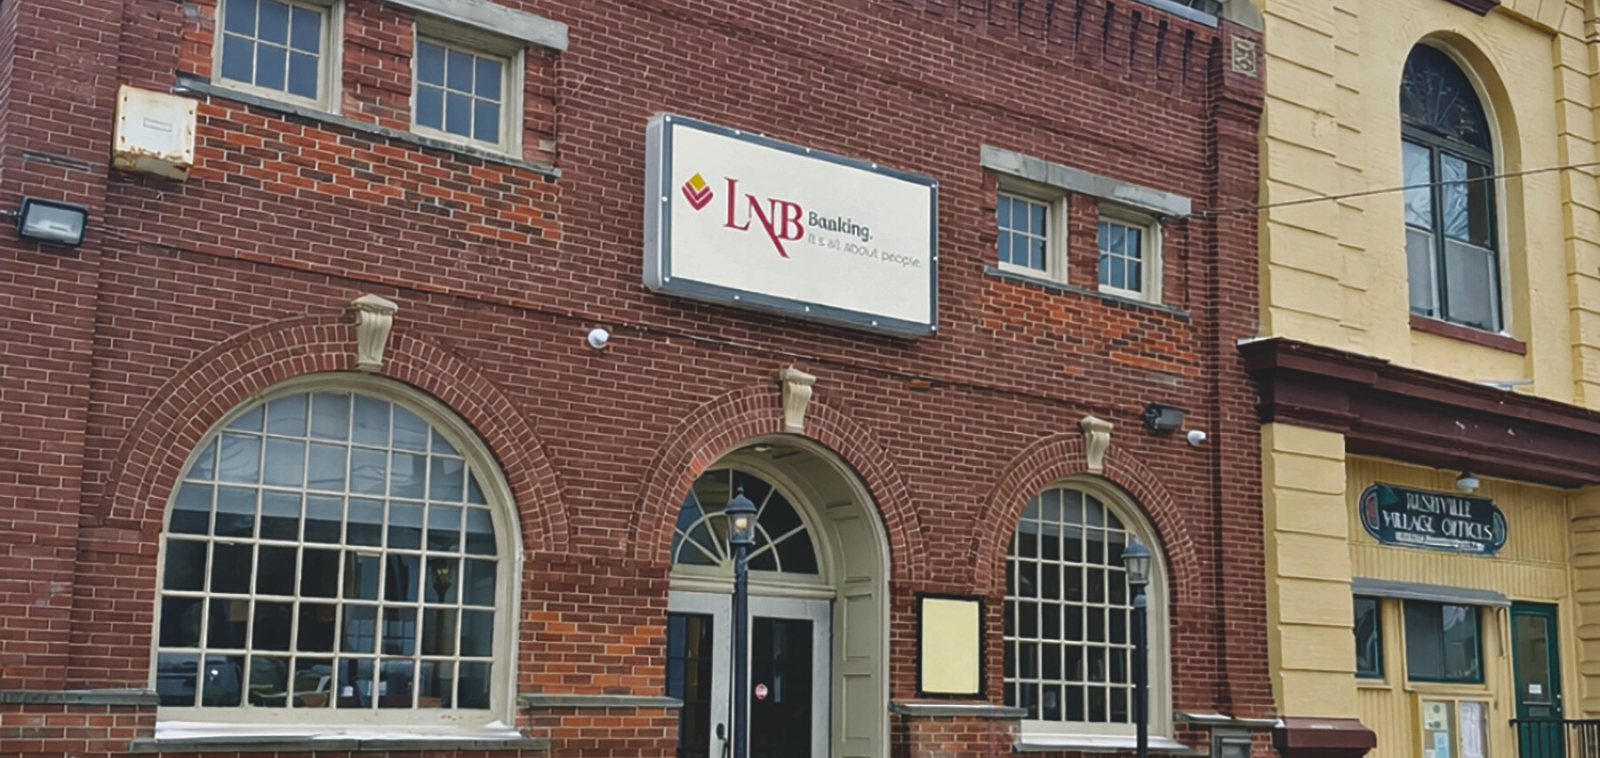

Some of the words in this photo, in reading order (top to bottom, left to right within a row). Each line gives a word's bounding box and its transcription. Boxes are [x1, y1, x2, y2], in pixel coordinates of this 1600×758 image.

[723, 176, 805, 259] LNB
[808, 211, 874, 243] Banking.
[844, 243, 880, 259] about
[1382, 509, 1436, 533] VILLAGE
[1441, 518, 1493, 540] OFFICES
